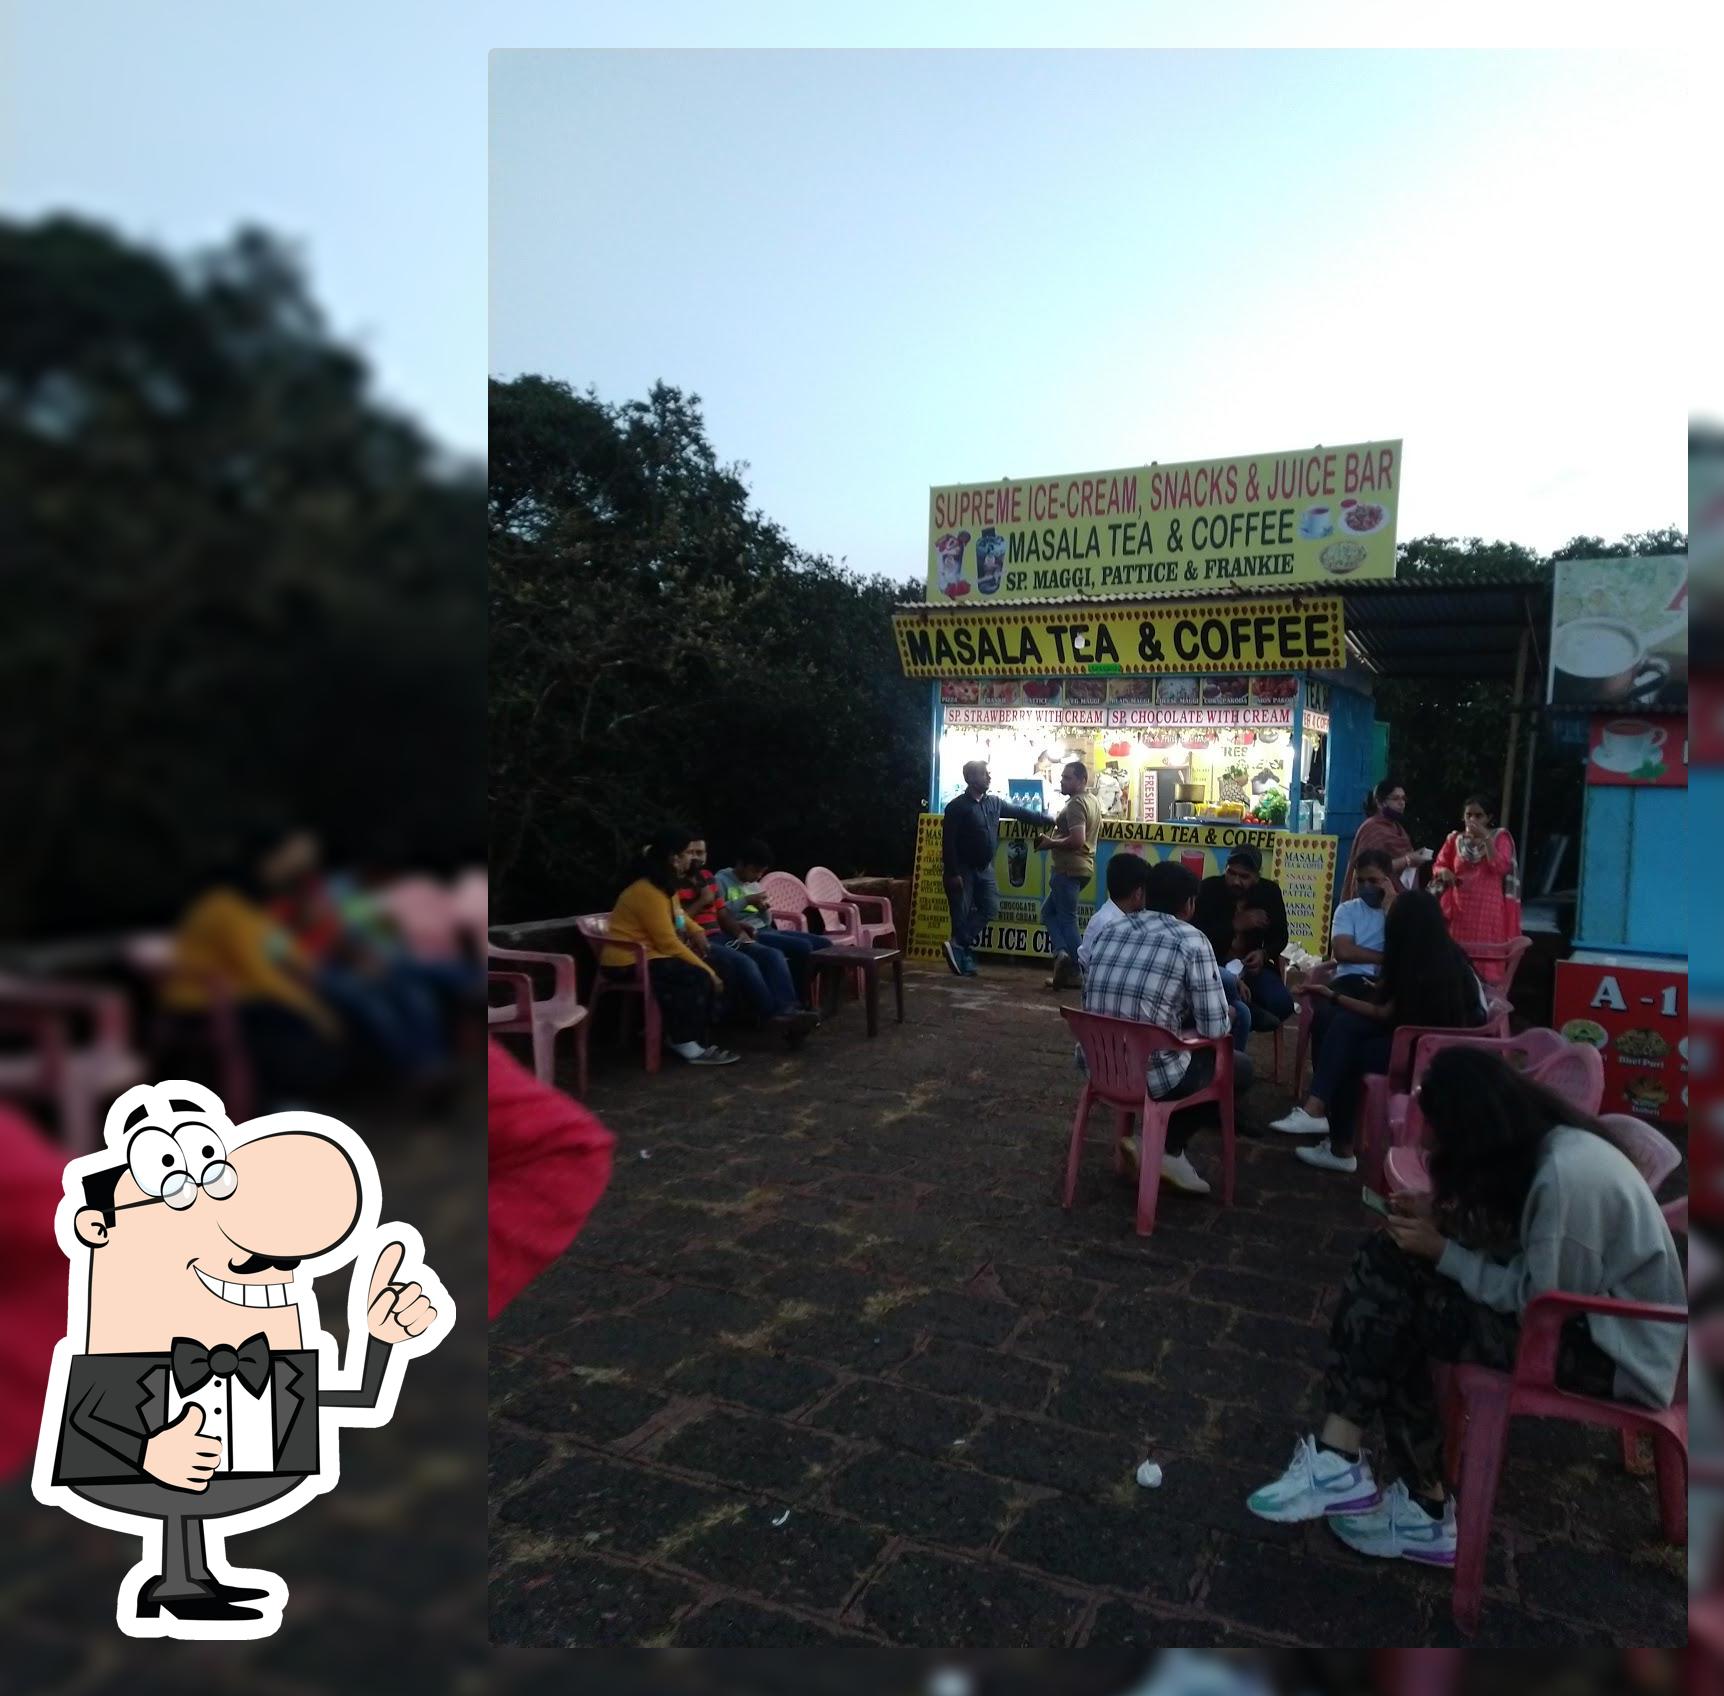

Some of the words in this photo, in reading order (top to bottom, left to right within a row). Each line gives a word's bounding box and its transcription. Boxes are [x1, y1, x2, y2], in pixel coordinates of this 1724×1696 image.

[935, 487, 1022, 528] SUPREME
[1028, 475, 1143, 521] ICE-CREAM,
[1151, 464, 1238, 512] SNACKS
[1245, 462, 1260, 502] &
[1268, 454, 1337, 501] JUICE
[1345, 448, 1394, 493] BAR
[1008, 525, 1100, 564] MASALA
[1108, 520, 1154, 557] TEA
[1167, 518, 1184, 552] &
[1191, 508, 1295, 551] COFFEE
[1006, 571, 1027, 592] SP.
[1033, 567, 1096, 590] MAGGI,
[1101, 560, 1179, 585] PATTICE
[1184, 560, 1199, 581] &
[1205, 553, 1295, 579] FRANKIE
[905, 625, 1043, 666] MASALA
[1046, 623, 1120, 663] TEA
[1138, 621, 1165, 662] &
[1173, 614, 1331, 662] COFFEE
[949, 709, 961, 722] SP.
[963, 710, 1032, 722] STRAWBERRY
[1036, 710, 1063, 722] WITH
[1064, 710, 1104, 724] CREAM
[1131, 711, 1203, 724] CHOCOLATE
[1207, 710, 1239, 724] WITH
[1243, 709, 1291, 724] CREAM
[1144, 775, 1155, 805] FRESH
[1101, 822, 1165, 842] MASALA
[1171, 826, 1199, 844] TEA
[1204, 827, 1217, 845] &
[1222, 829, 1275, 849] COFFE
[1285, 851, 1324, 863] MASALA
[1286, 873, 1317, 881] SNACKS
[1289, 882, 1313, 891] TAWA
[1282, 890, 1317, 898] PATTICE
[997, 927, 1028, 951] ICE
